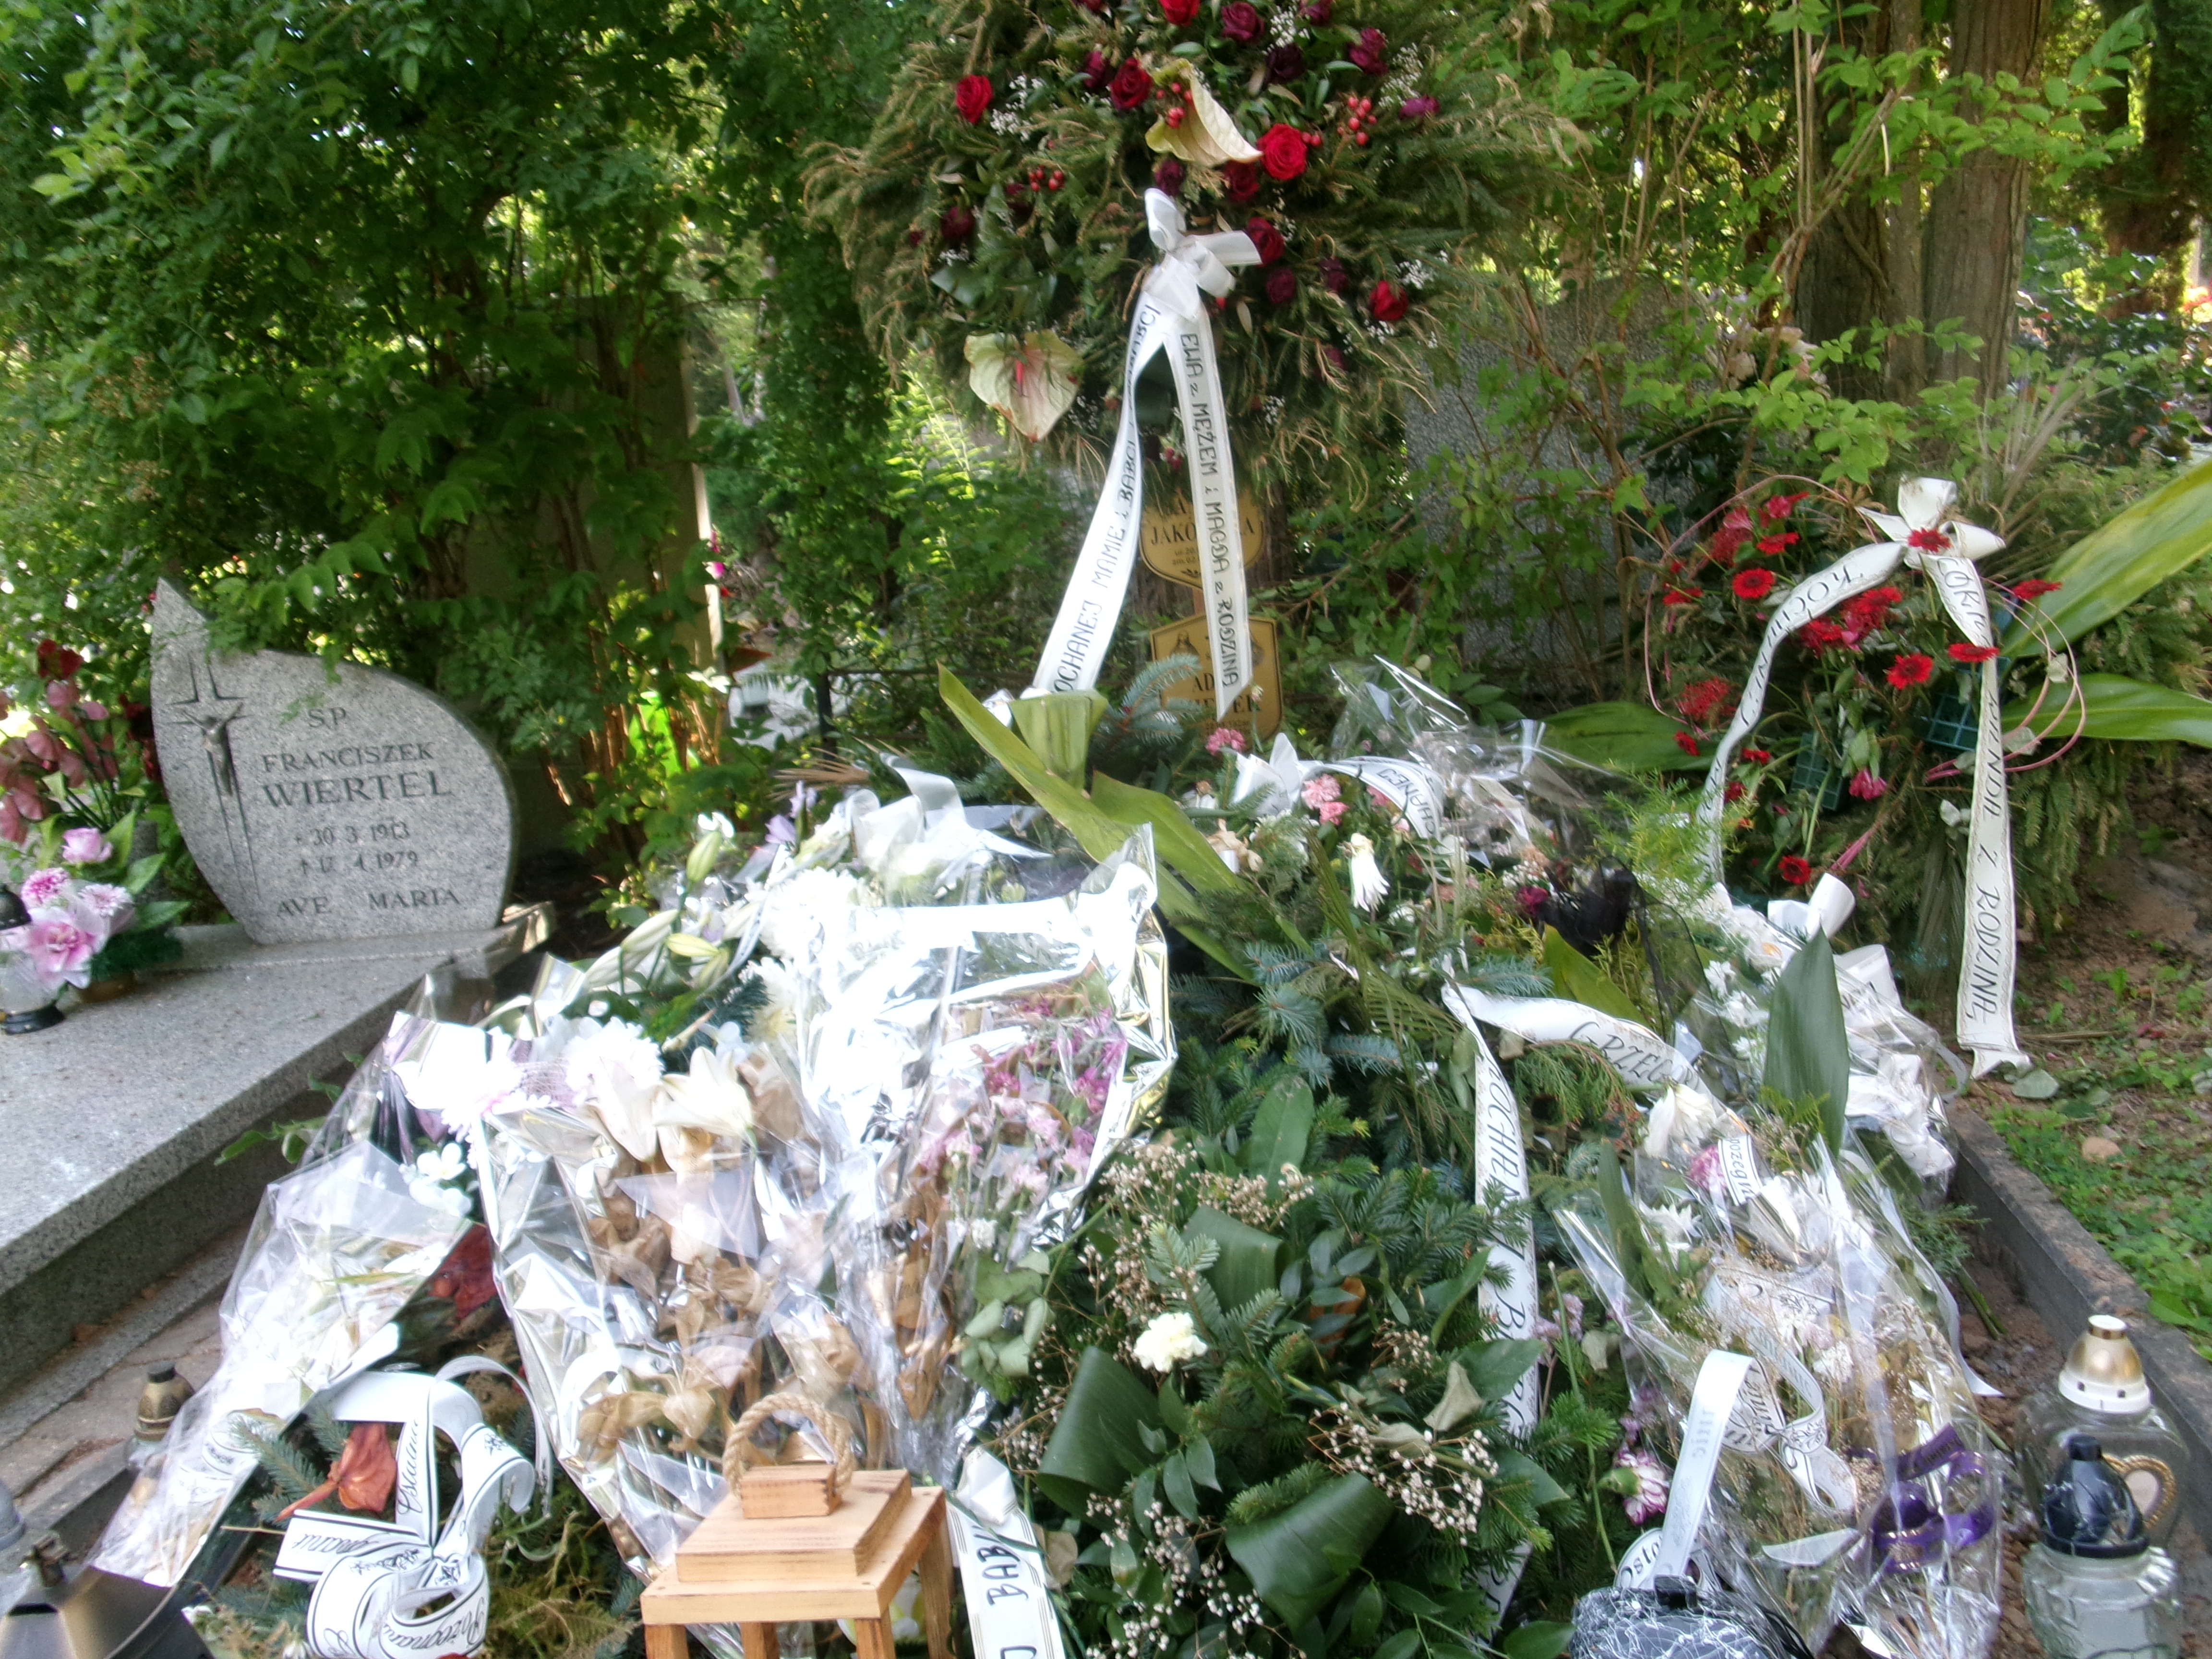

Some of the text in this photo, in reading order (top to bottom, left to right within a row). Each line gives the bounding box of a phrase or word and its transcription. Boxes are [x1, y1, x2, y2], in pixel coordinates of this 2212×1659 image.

[1180, 333, 1203, 378] EWA
[1204, 501, 1231, 574] MAGDA
[1054, 599, 1102, 693] OCHANEJ
[1091, 526, 1126, 589] MAMIE
[1118, 440, 1136, 506] BABCI
[262, 741, 435, 772] FRANCISZEK
[262, 770, 454, 808] WIERTEL
[1376, 768, 1436, 835] CHANEJ
[276, 888, 461, 918] AVE MARIA
